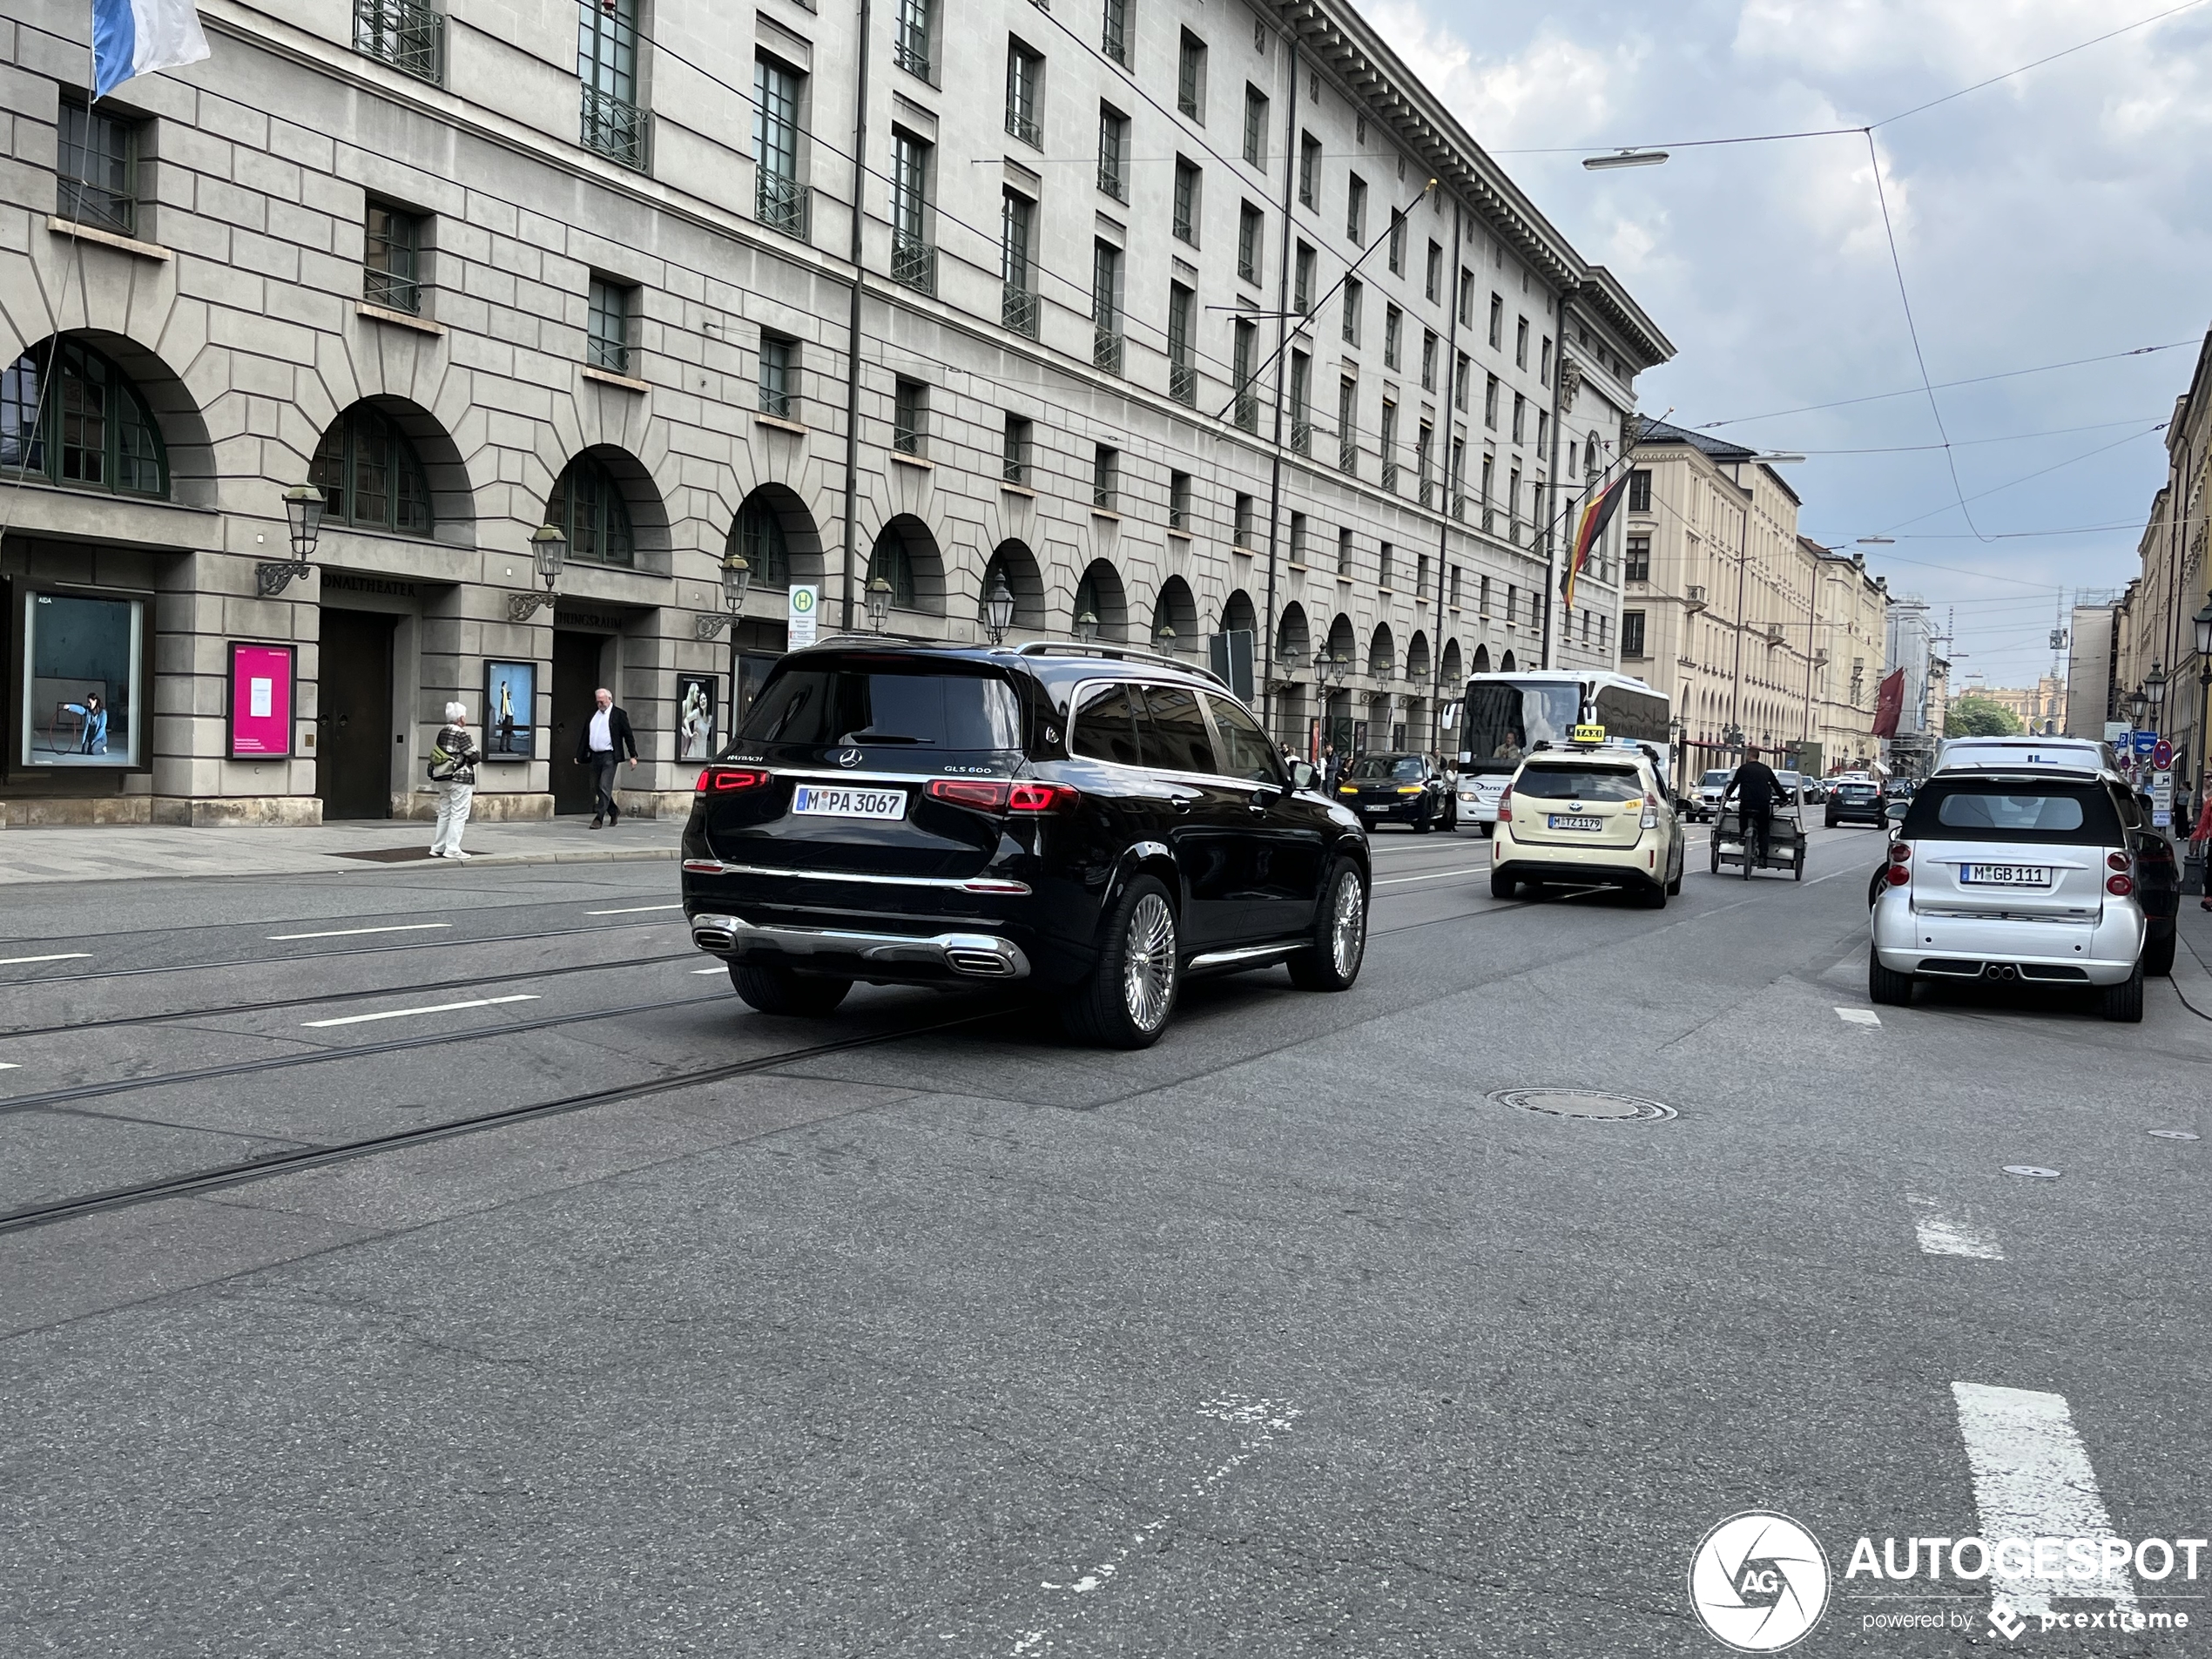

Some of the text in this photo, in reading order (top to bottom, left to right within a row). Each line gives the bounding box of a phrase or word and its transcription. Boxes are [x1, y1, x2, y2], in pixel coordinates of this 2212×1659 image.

[1578, 729, 1602, 738] TAXI
[806, 791, 820, 810] M
[853, 793, 900, 814] 3067
[1578, 818, 1601, 828] 1179
[1973, 866, 2043, 882] M GB 111
